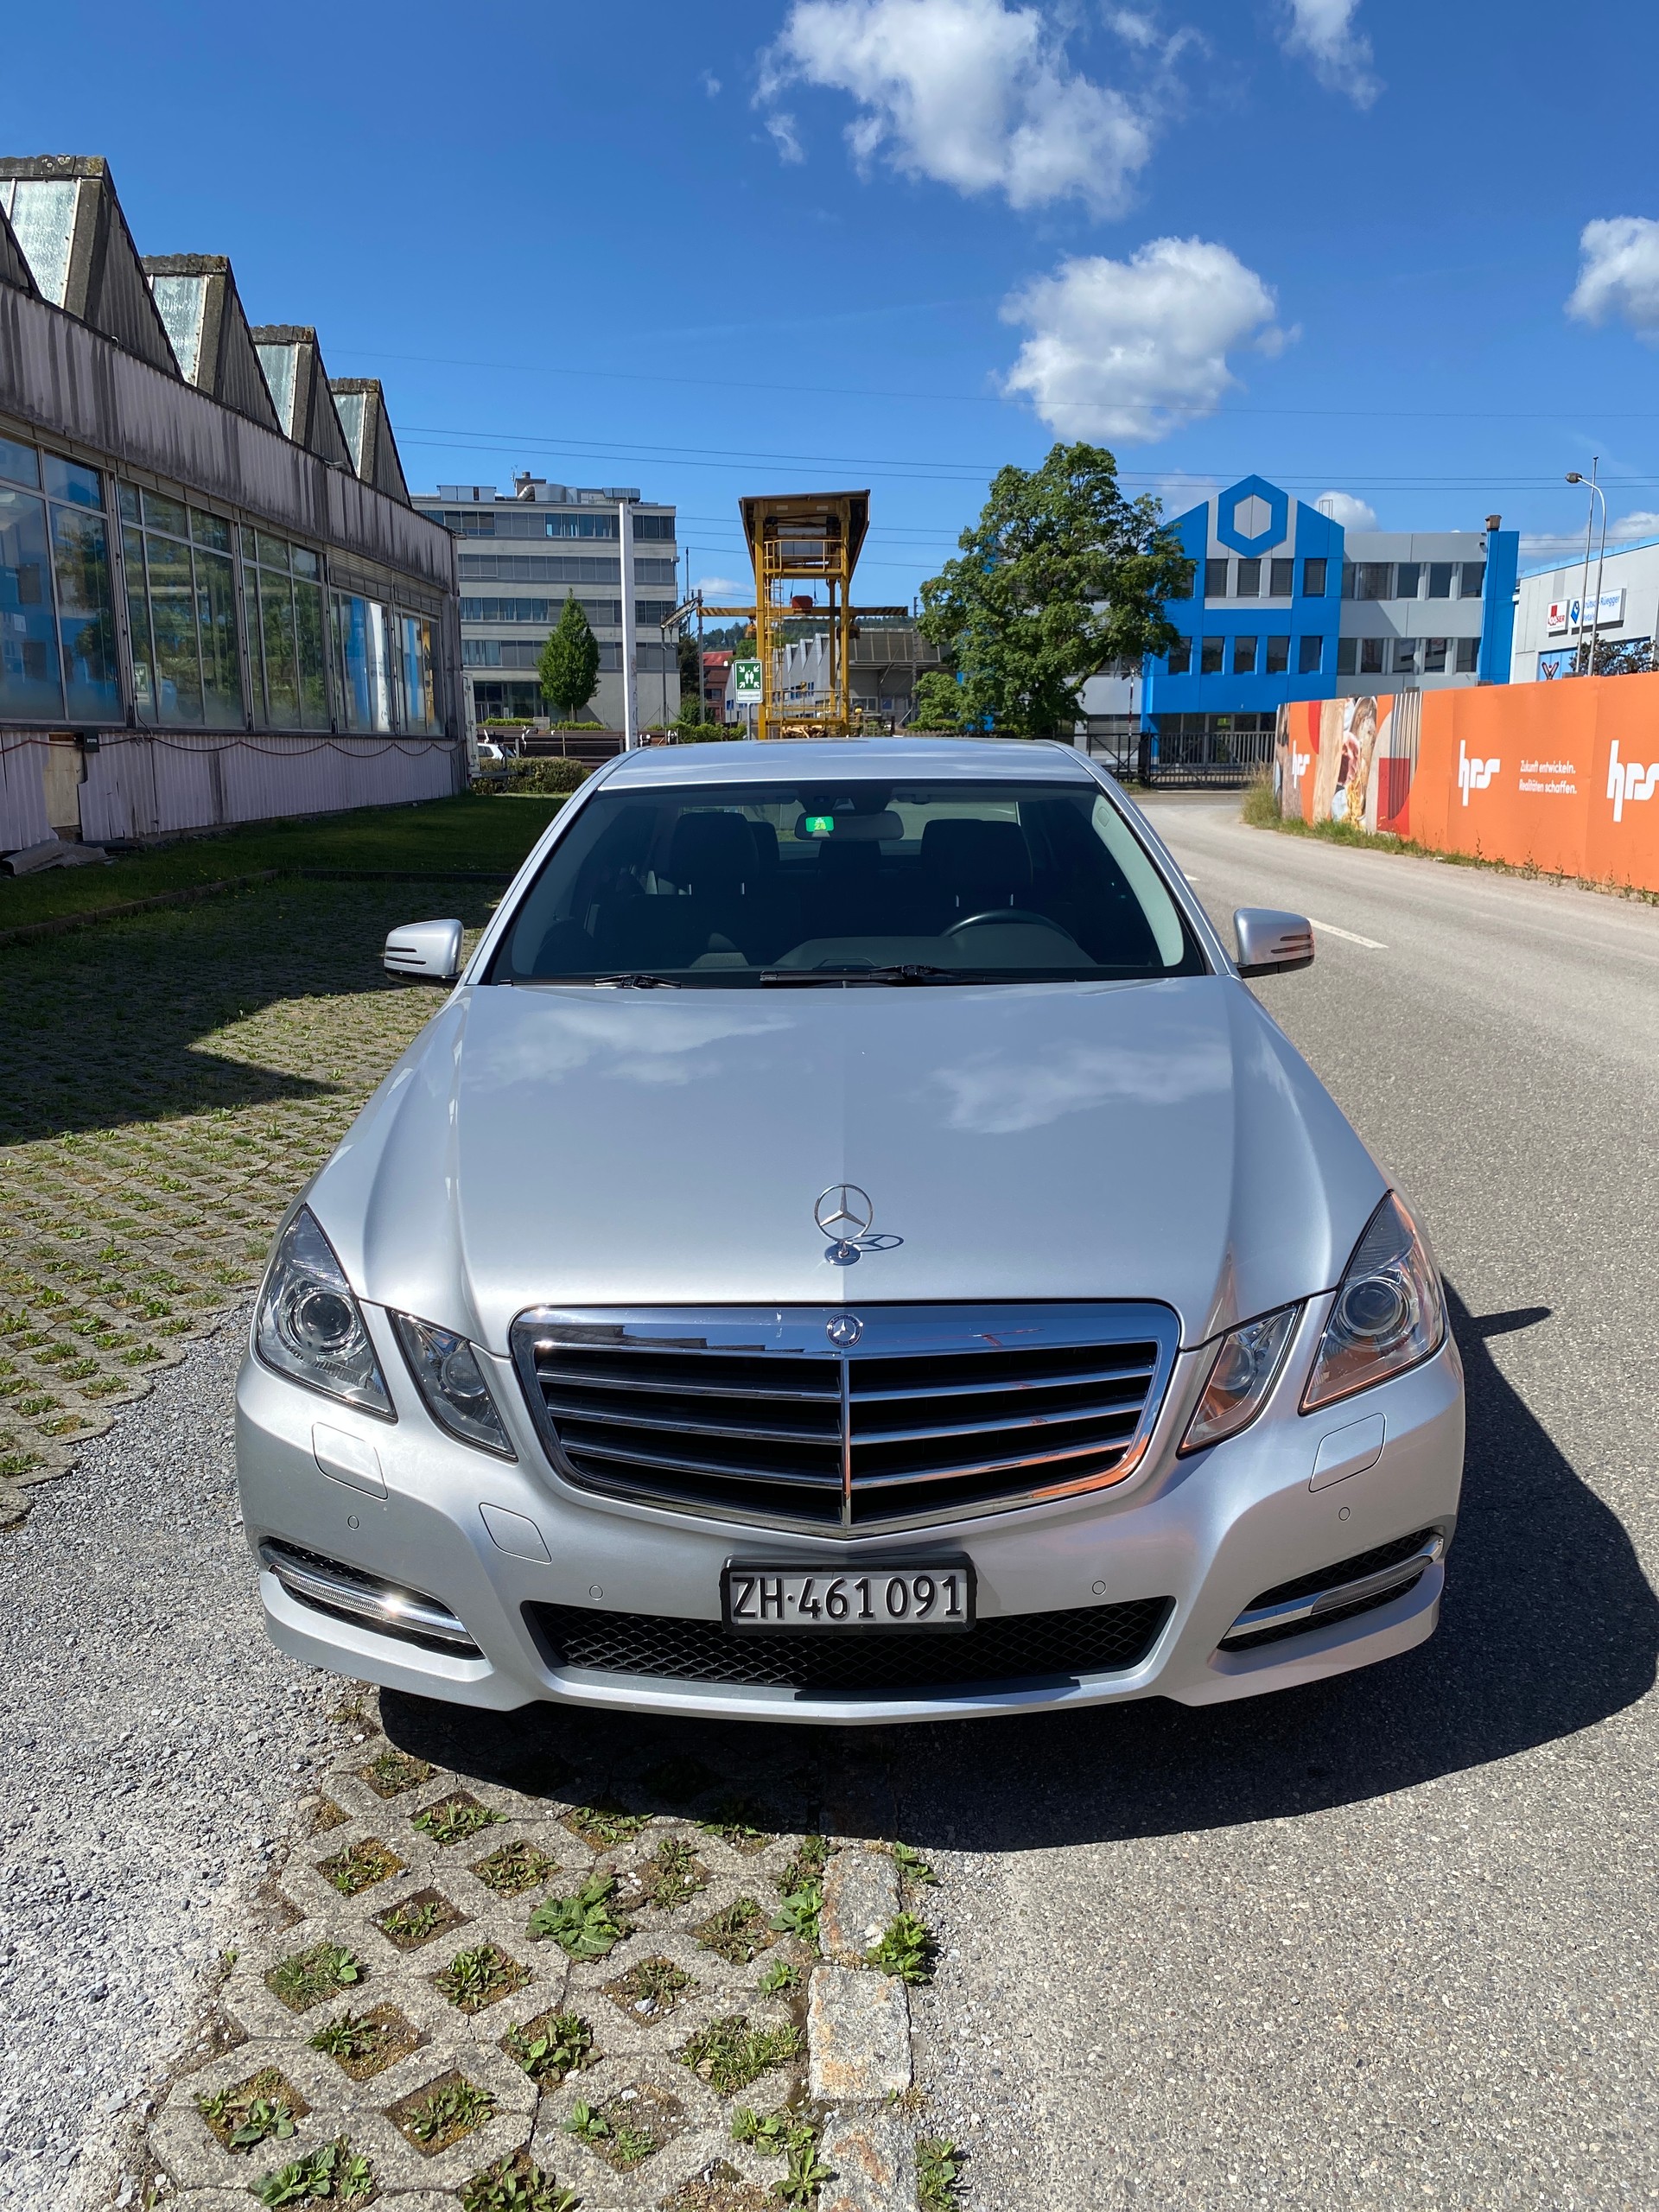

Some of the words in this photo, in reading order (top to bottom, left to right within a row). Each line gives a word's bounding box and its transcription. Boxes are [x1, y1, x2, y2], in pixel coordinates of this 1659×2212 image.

[1292, 740, 1310, 788] hrs
[1459, 740, 1500, 806] hrs
[1519, 779, 1544, 792] Realitäten
[1545, 779, 1577, 794] schaffen.
[1520, 760, 1538, 772] Zukunft
[1539, 760, 1576, 774] entwickeln.
[1606, 740, 1659, 822] hrs
[884, 1575, 962, 1618] 091
